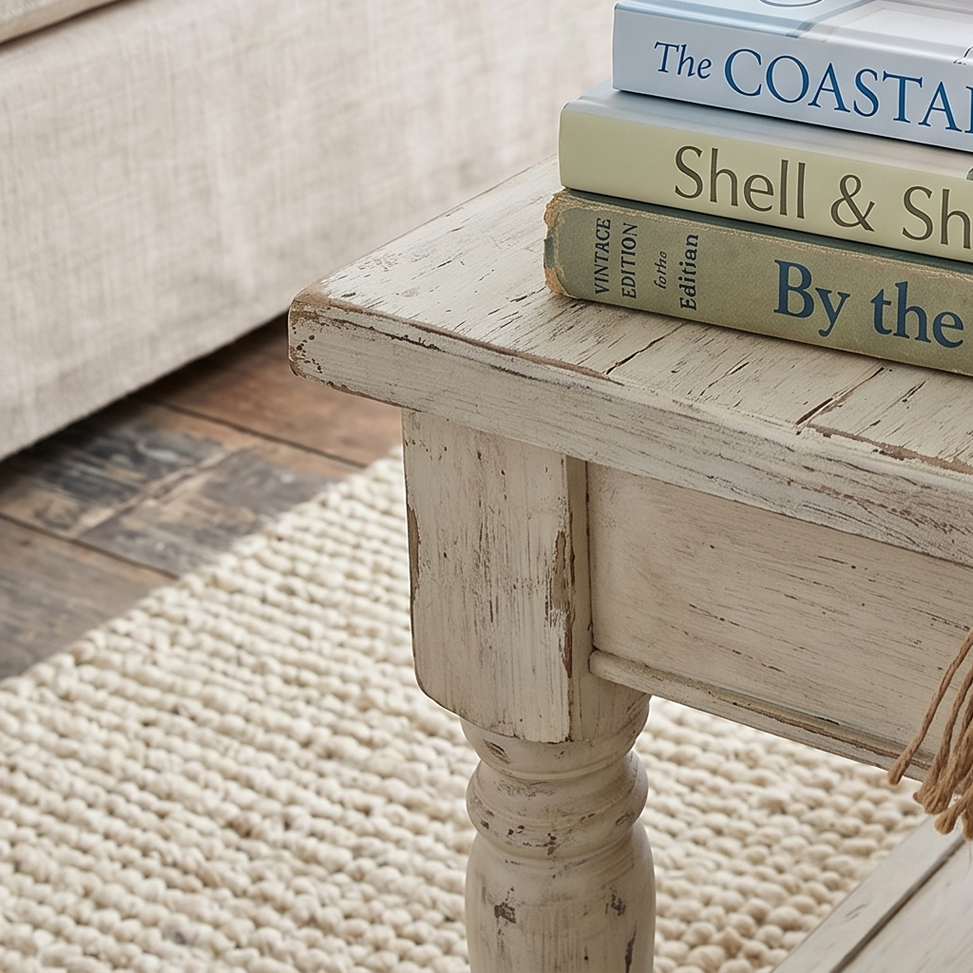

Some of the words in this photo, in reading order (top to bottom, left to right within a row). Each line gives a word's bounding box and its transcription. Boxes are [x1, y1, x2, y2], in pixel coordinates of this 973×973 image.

[653, 41, 712, 79] The
[674, 145, 806, 219] Shell
[830, 174, 875, 232] &
[621, 222, 638, 299] EDITION
[773, 259, 850, 337] By
[870, 281, 964, 348] the
